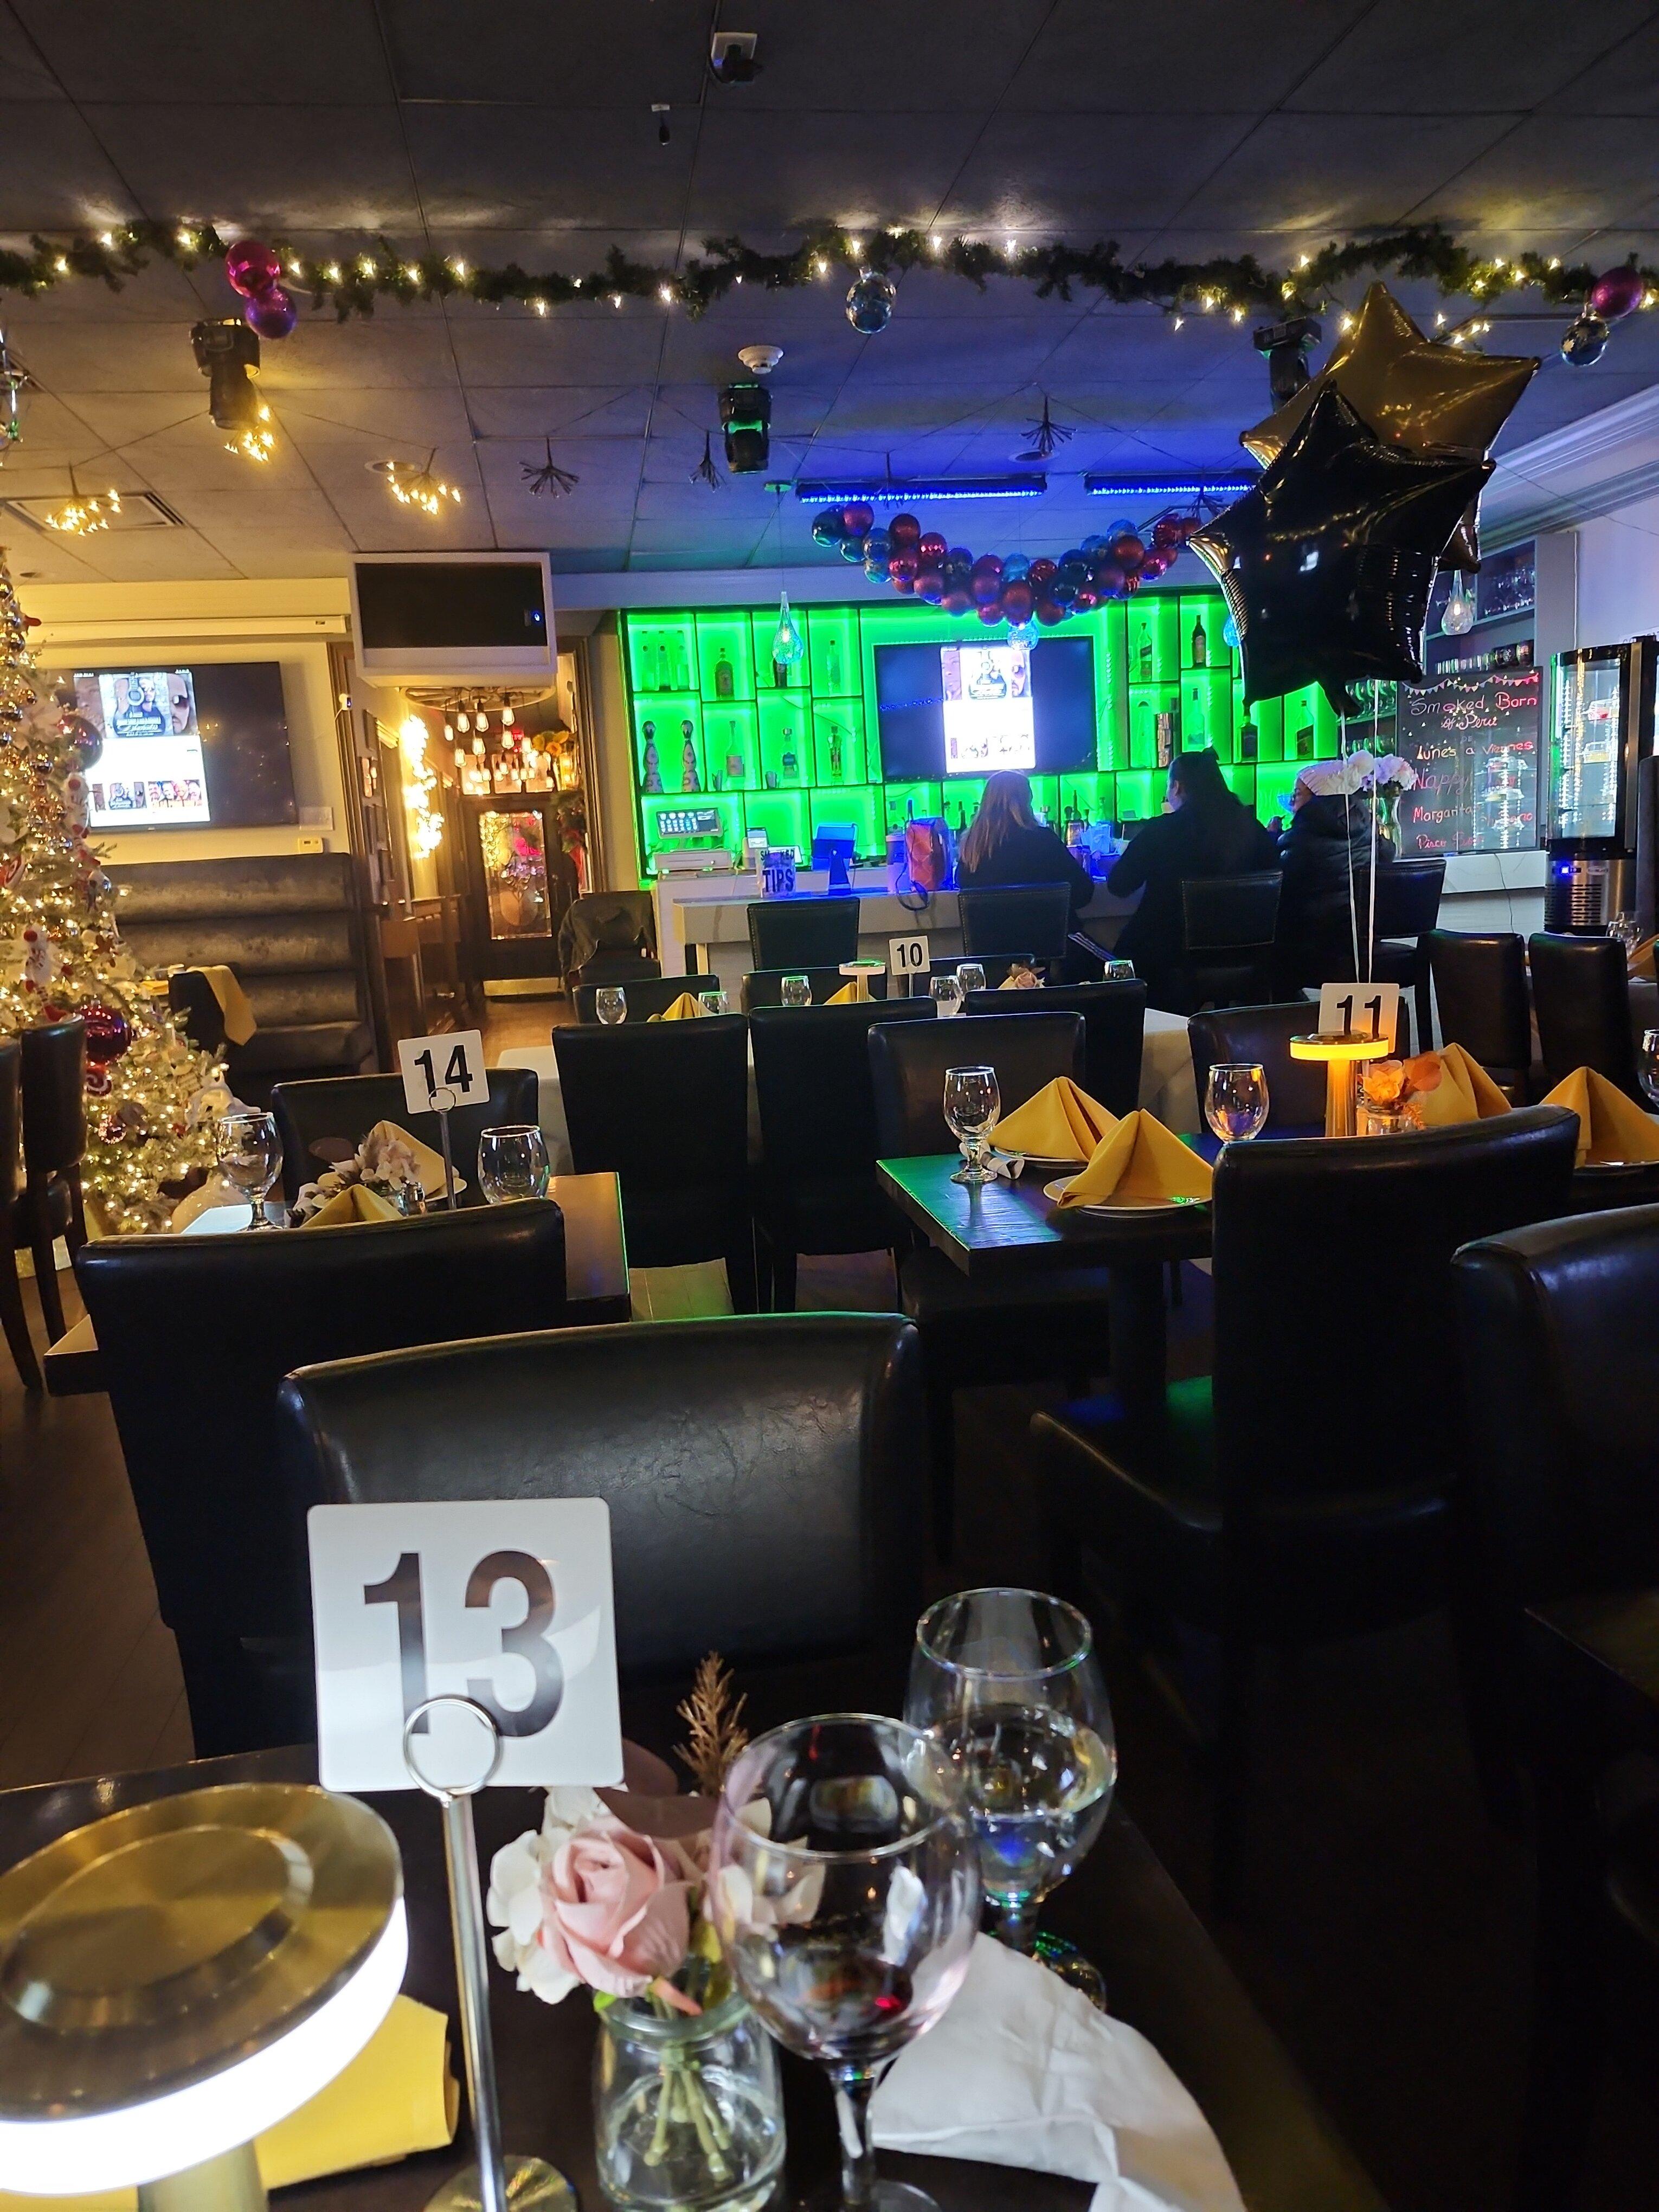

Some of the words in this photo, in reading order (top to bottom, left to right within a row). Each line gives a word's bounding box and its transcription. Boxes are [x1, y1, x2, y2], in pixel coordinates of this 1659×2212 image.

[1410, 695, 1485, 716] Smoked
[1465, 747, 1475, 755] a
[762, 868, 794, 893] TIPS
[896, 943, 923, 968] 10
[1336, 995, 1381, 1039] 11
[414, 1044, 473, 1098] 14
[363, 1549, 564, 1737] 13
